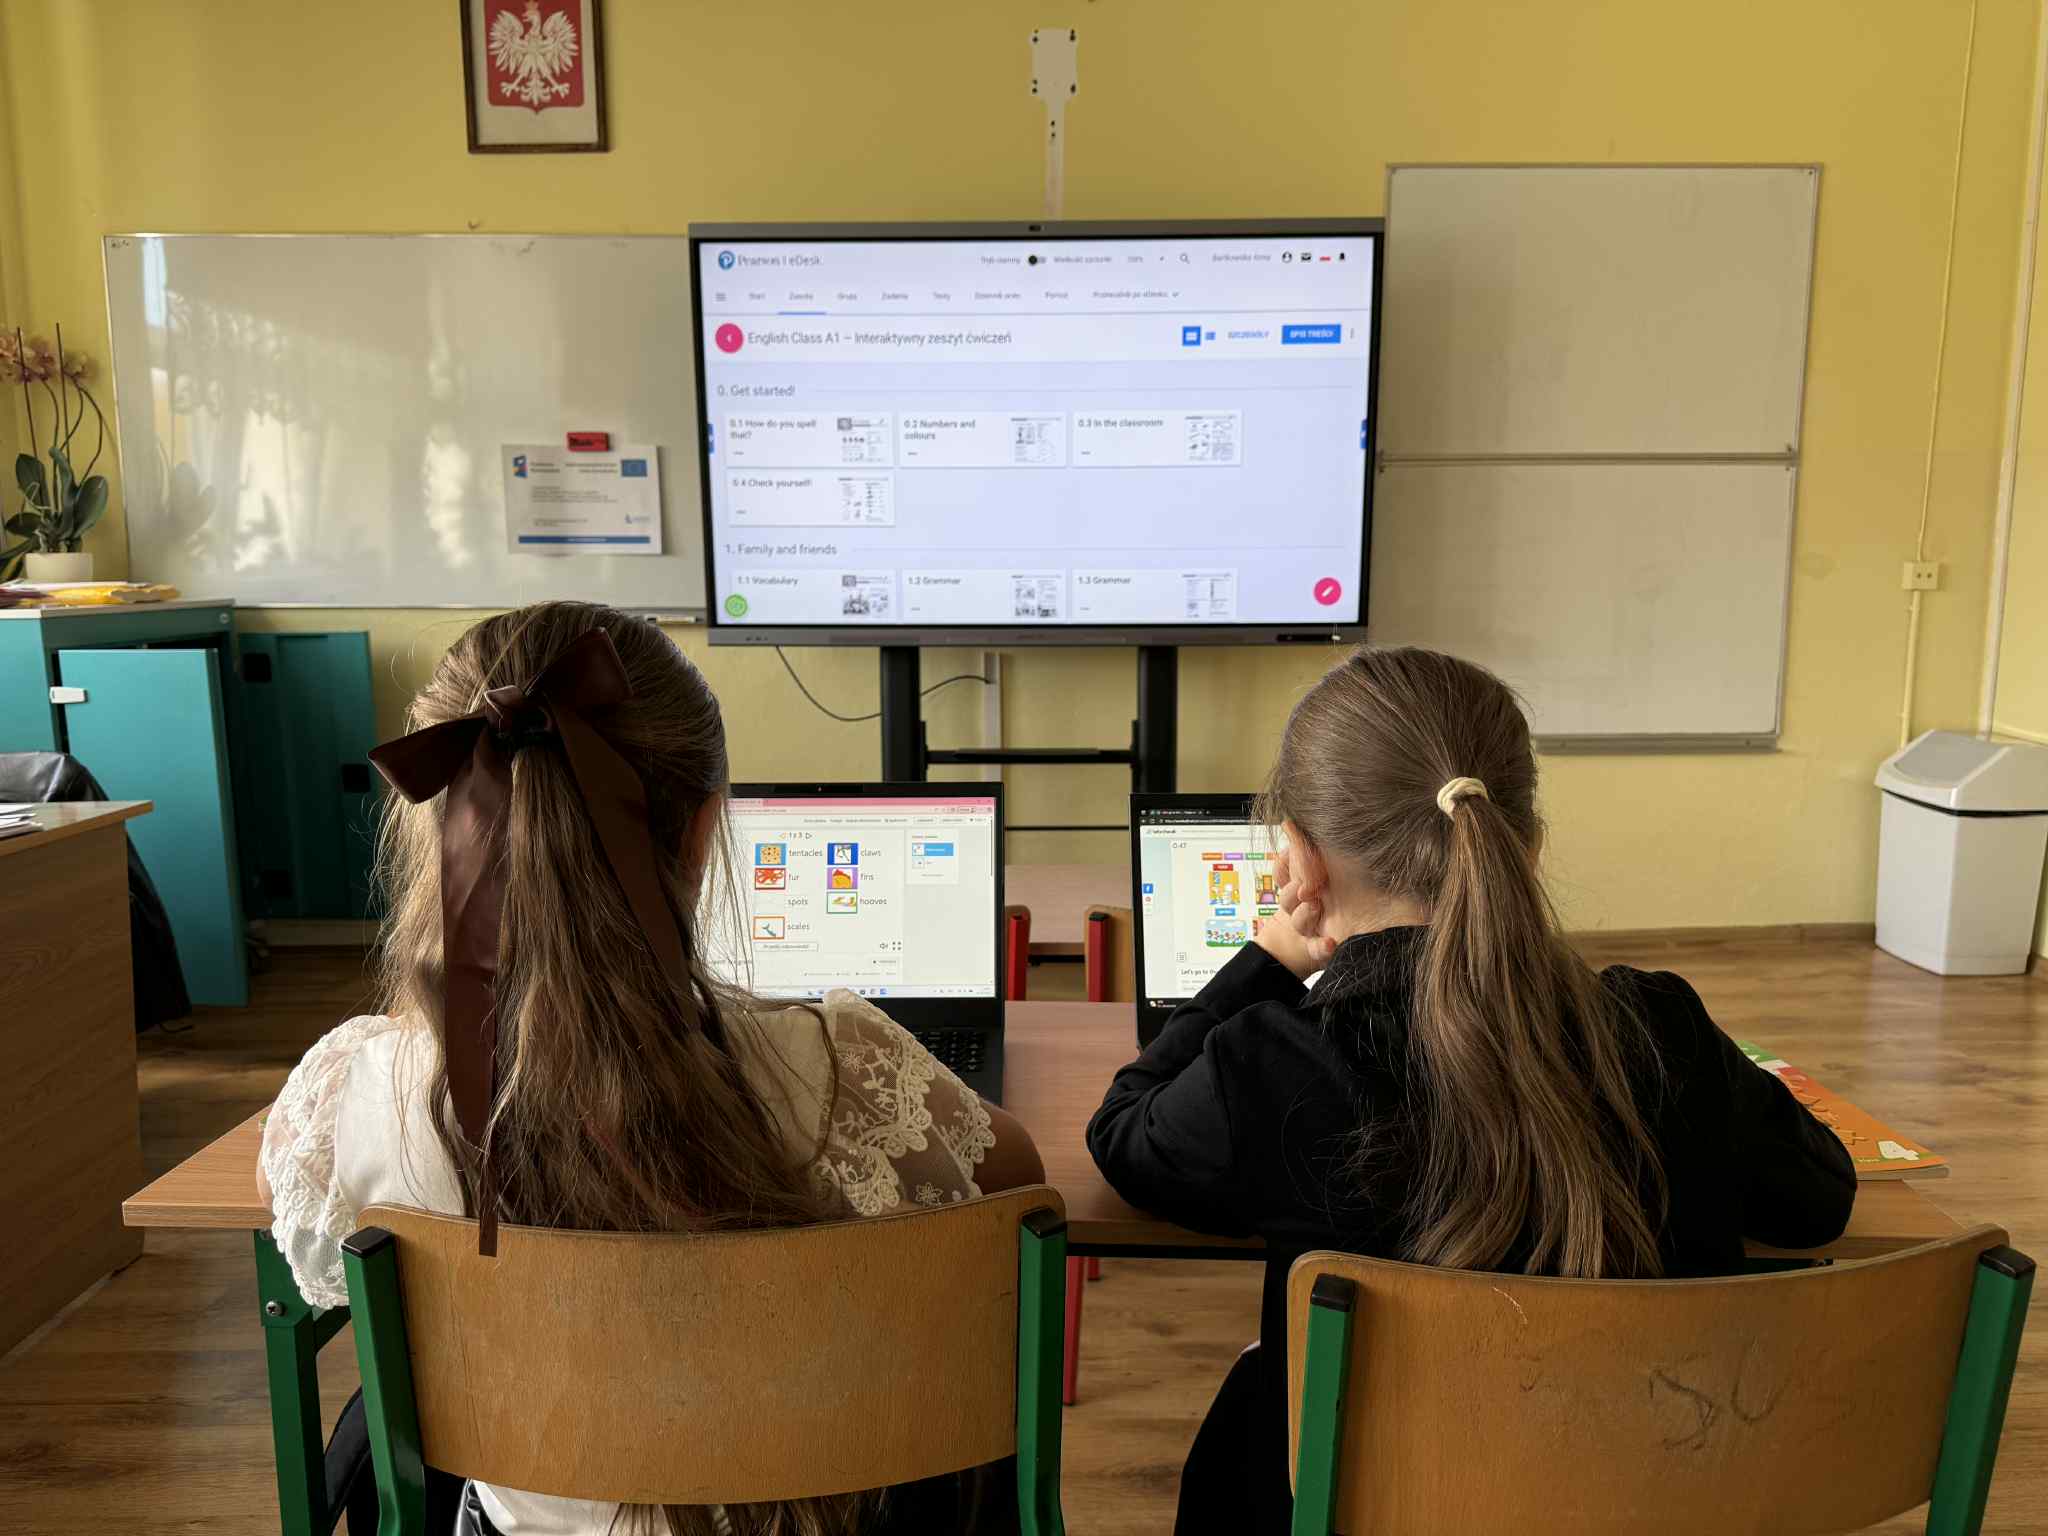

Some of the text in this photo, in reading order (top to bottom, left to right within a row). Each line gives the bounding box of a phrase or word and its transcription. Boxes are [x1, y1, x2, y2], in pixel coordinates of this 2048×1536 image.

[748, 331, 789, 346] English
[790, 331, 822, 344] Class
[825, 331, 840, 344] A1
[854, 330, 925, 347] Interaktywny
[927, 332, 964, 347] zeszyt
[966, 329, 1012, 344] ćwiczeń
[717, 384, 796, 397] 0. Get started!
[745, 419, 765, 428] How
[766, 419, 778, 428] do
[779, 421, 794, 430] you
[796, 419, 816, 430] spell
[919, 418, 959, 430] Numbers
[960, 419, 976, 429] and
[1103, 418, 1118, 428] the
[1119, 418, 1163, 428] classroom
[904, 431, 936, 441] colours
[748, 478, 774, 488] Check
[738, 543, 774, 558] Family
[776, 543, 797, 555] and
[799, 543, 838, 555] friends
[752, 575, 799, 587] Vocabulary
[923, 576, 961, 586] Grammar
[1093, 575, 1131, 585] Grammar
[788, 849, 823, 857] tentacles
[860, 849, 881, 857] claws
[788, 873, 800, 881] fur
[860, 873, 875, 881] fins
[787, 897, 808, 906] spots
[859, 897, 887, 905] hooves
[787, 922, 810, 931] scales
